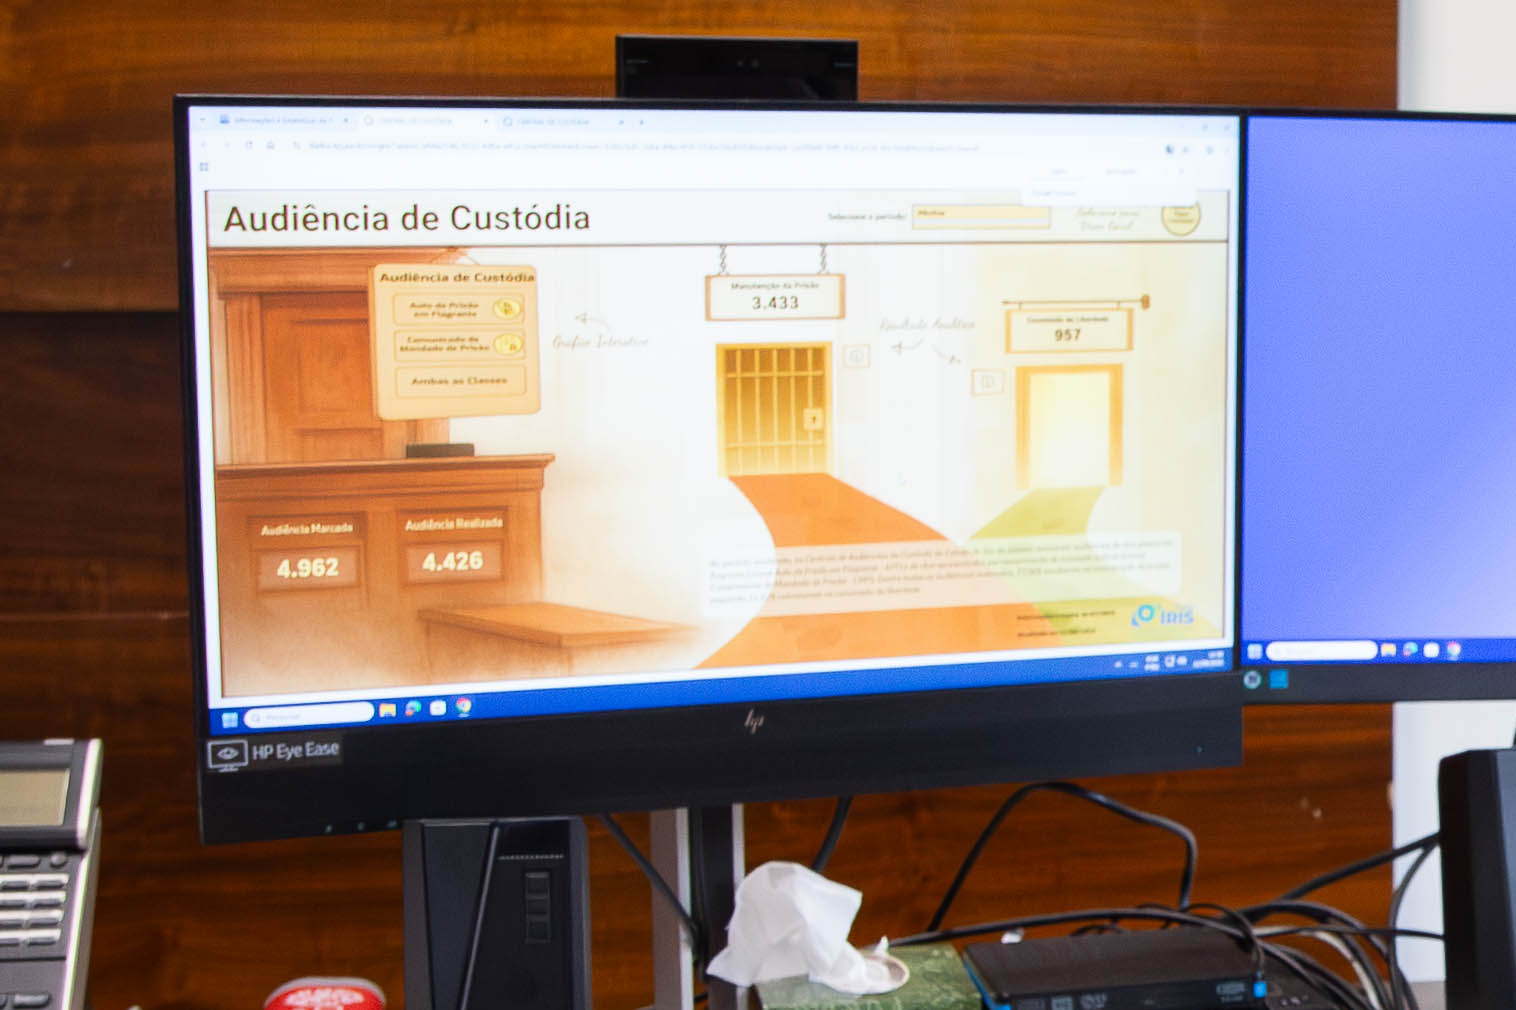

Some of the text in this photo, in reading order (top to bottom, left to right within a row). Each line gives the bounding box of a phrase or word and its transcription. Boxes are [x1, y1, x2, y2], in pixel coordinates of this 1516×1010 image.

[223, 203, 591, 232] Audiência de Custódia
[379, 271, 536, 284] Audiência de Custódia
[751, 295, 800, 310] 3.433
[1055, 328, 1081, 342] 957
[260, 523, 310, 537] Audiência
[405, 517, 455, 532] Audiência
[276, 557, 340, 579] 4.962
[422, 550, 484, 572] 4.426
[252, 740, 340, 762] HP Eye Ease
